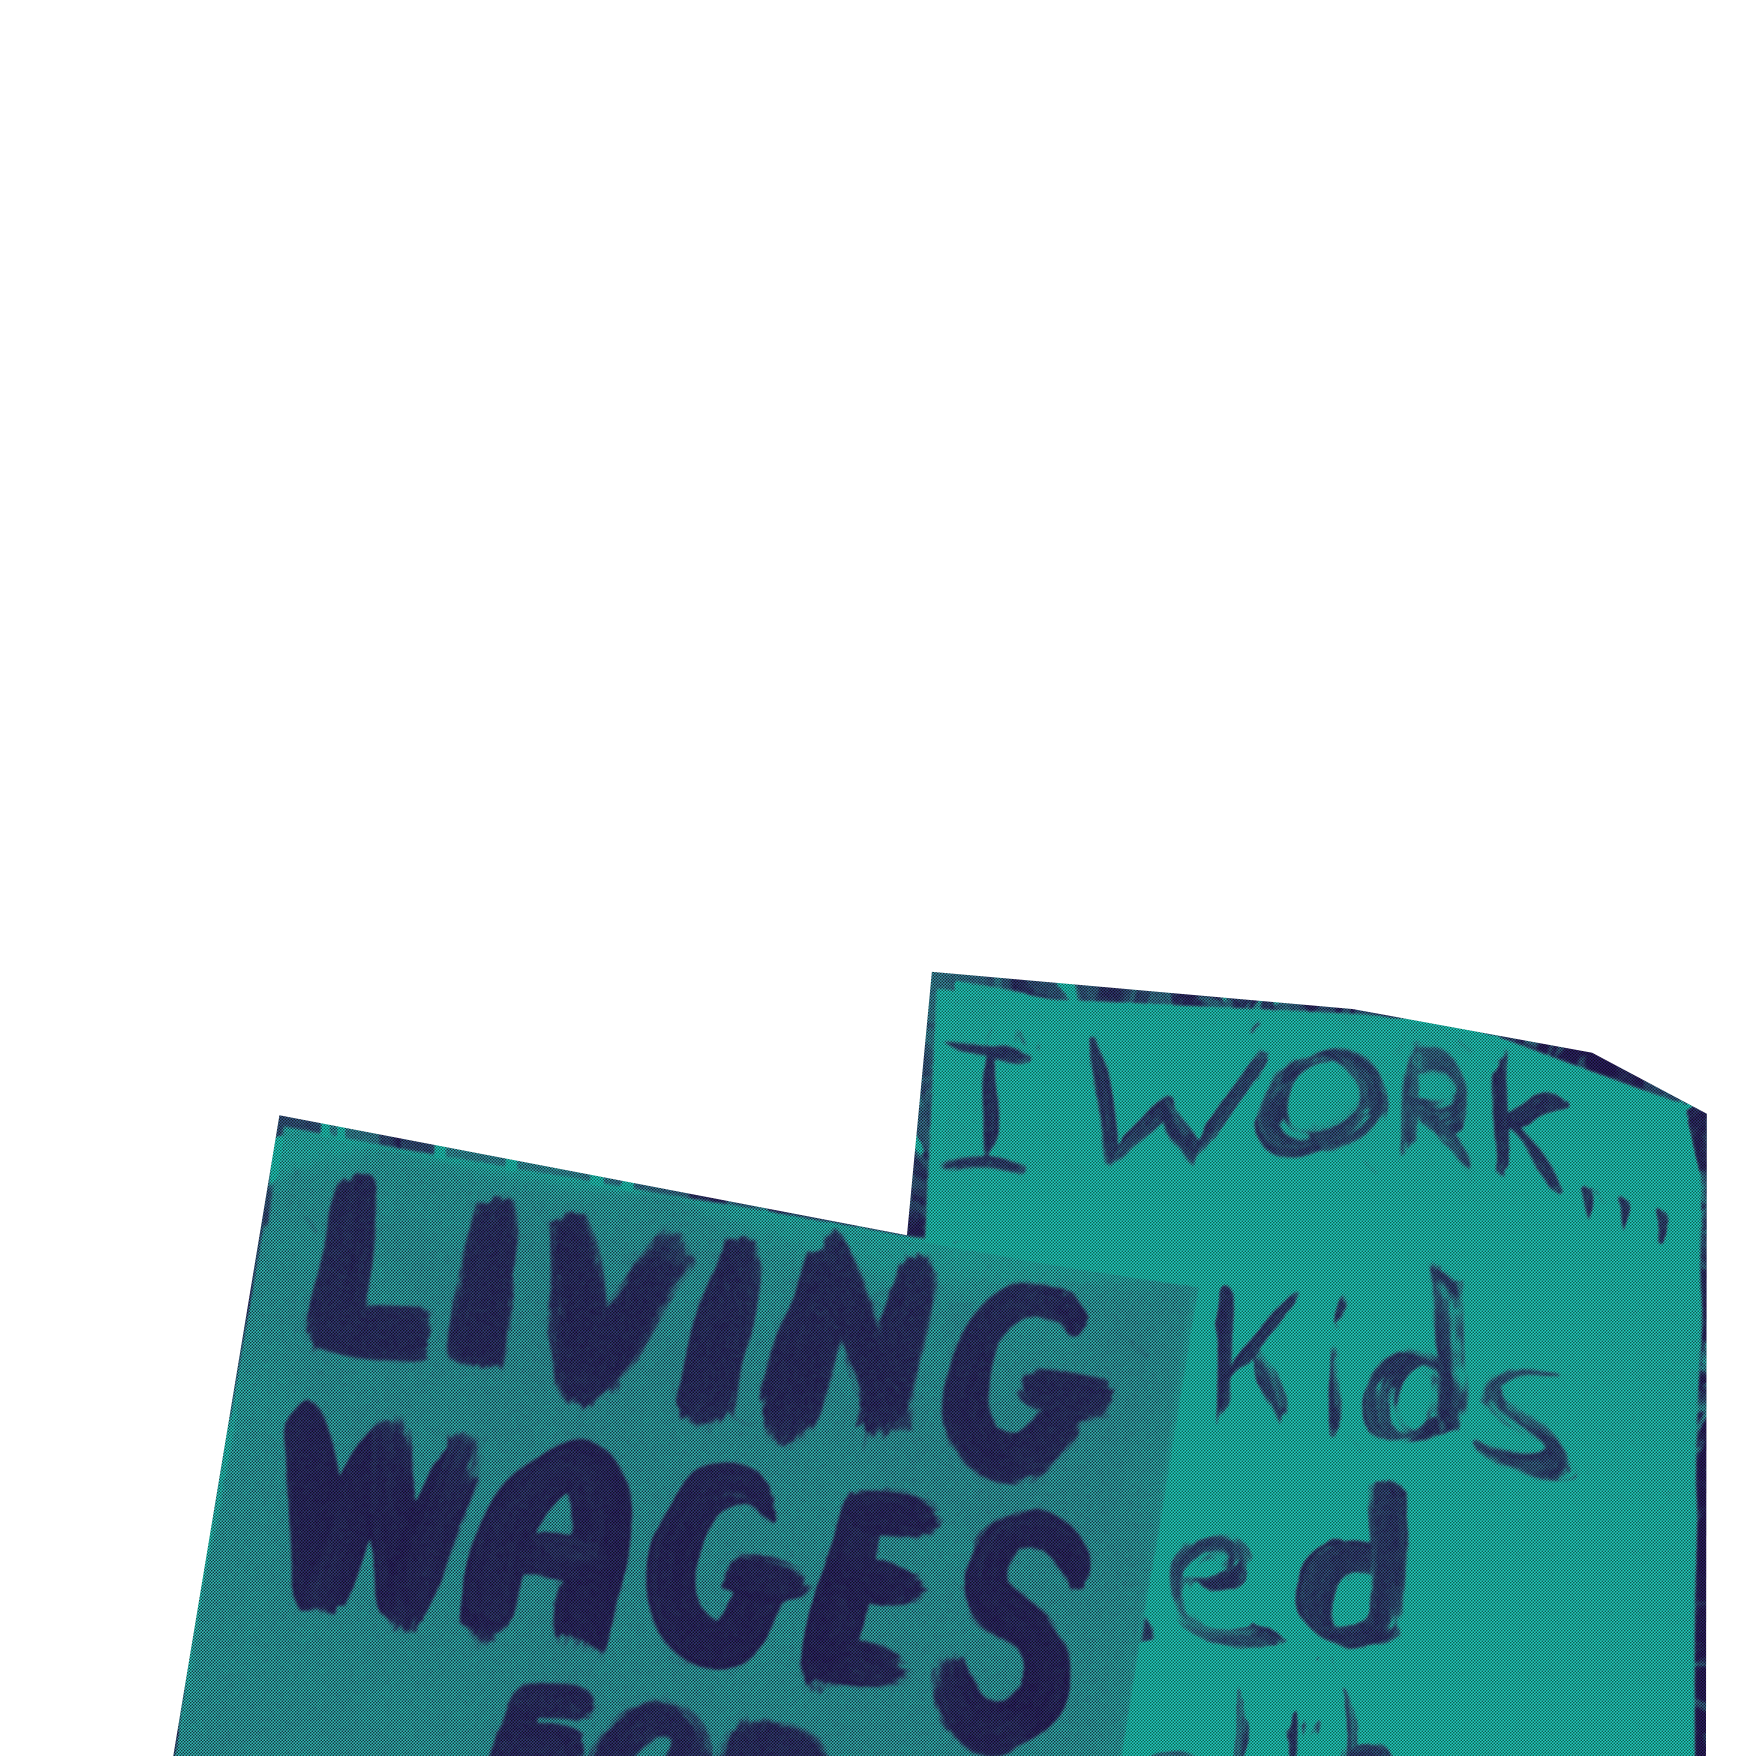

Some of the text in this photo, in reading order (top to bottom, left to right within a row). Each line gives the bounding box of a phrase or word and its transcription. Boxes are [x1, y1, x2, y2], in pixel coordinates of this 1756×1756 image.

[942, 1039, 1033, 1173] I
[304, 1172, 1116, 1484] LIVING
[1214, 1265, 1579, 1482] Kids
[283, 1399, 1091, 1756] WAGES
[1142, 1479, 1409, 1650] ed
